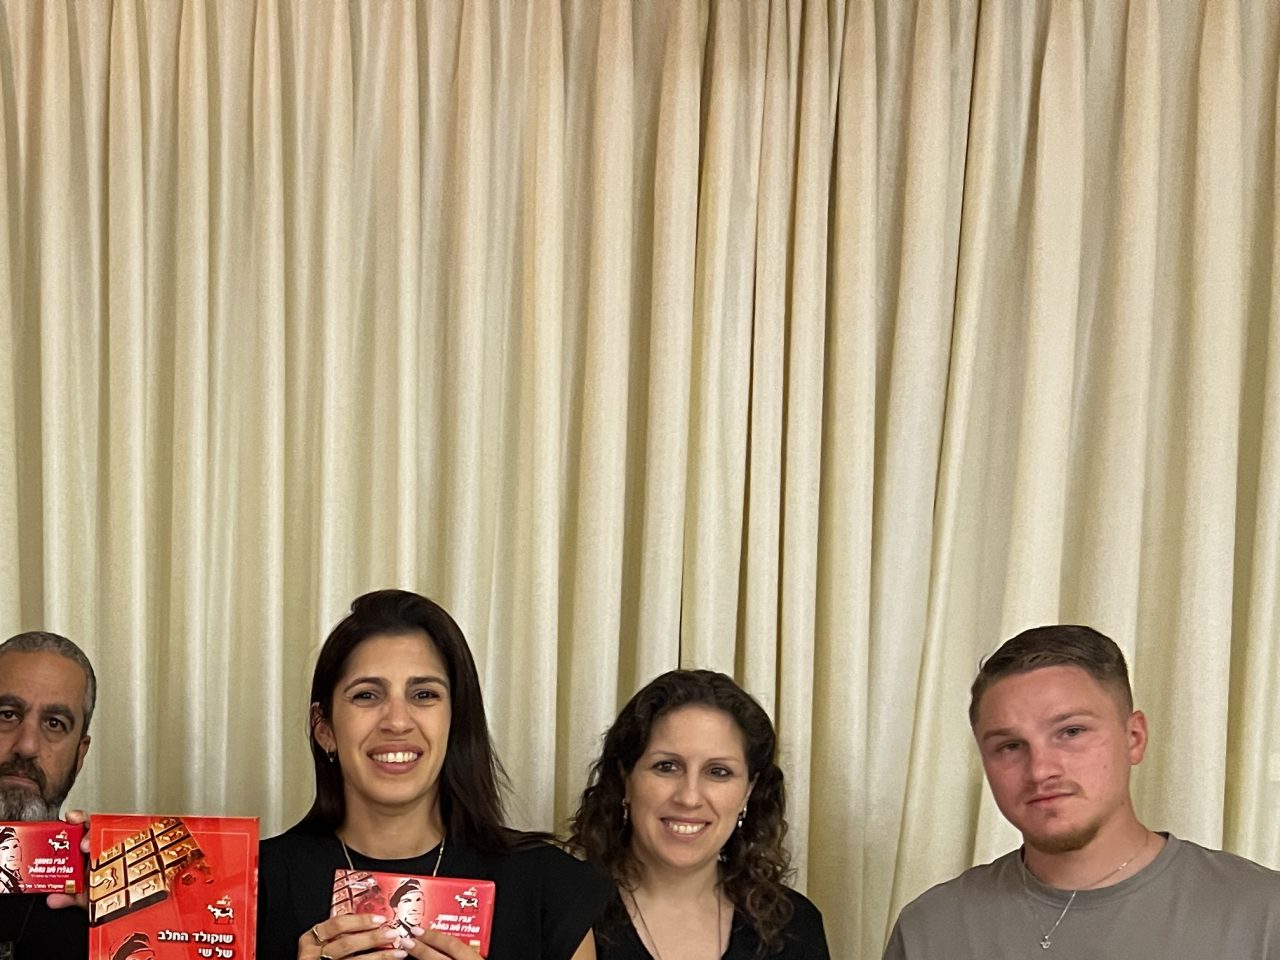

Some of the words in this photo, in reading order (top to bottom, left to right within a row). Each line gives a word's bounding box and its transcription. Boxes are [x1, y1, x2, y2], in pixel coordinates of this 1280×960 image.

[158, 930, 188, 941] החלב
[192, 931, 233, 945] שוקולד
[198, 948, 212, 958] שי
[215, 947, 233, 958] של
